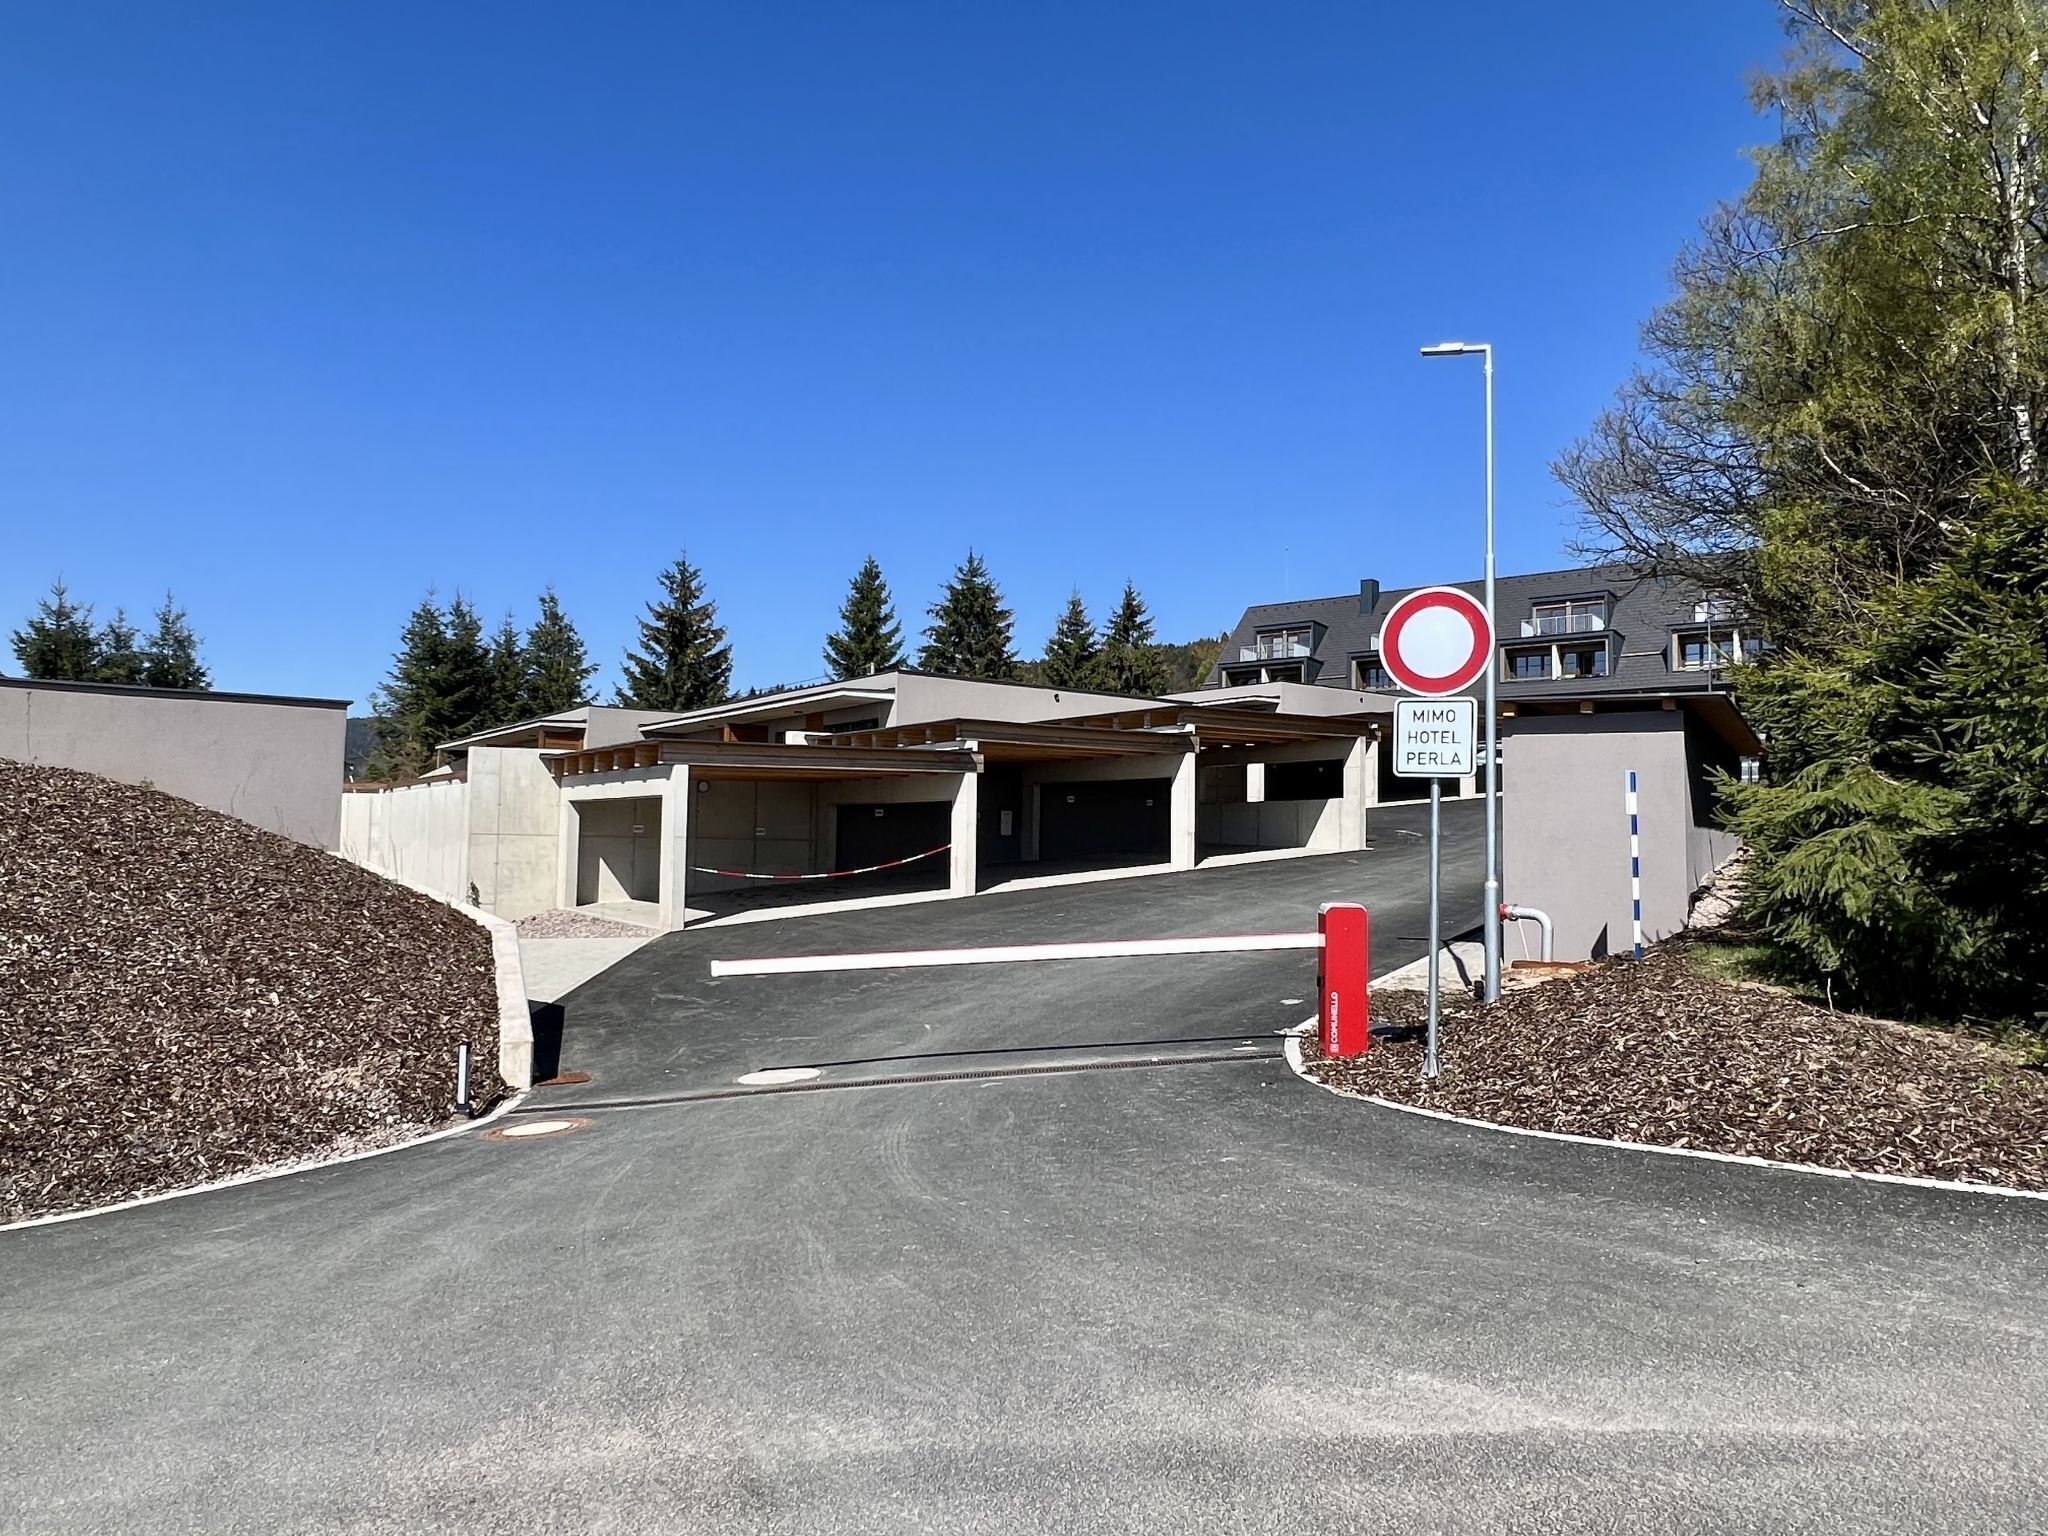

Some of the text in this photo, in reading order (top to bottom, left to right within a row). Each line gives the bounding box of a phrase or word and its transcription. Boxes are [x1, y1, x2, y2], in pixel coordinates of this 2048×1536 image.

[1413, 709, 1456, 723] MIMO
[1407, 730, 1461, 744] HOTEL
[1406, 752, 1462, 765] PERLA
